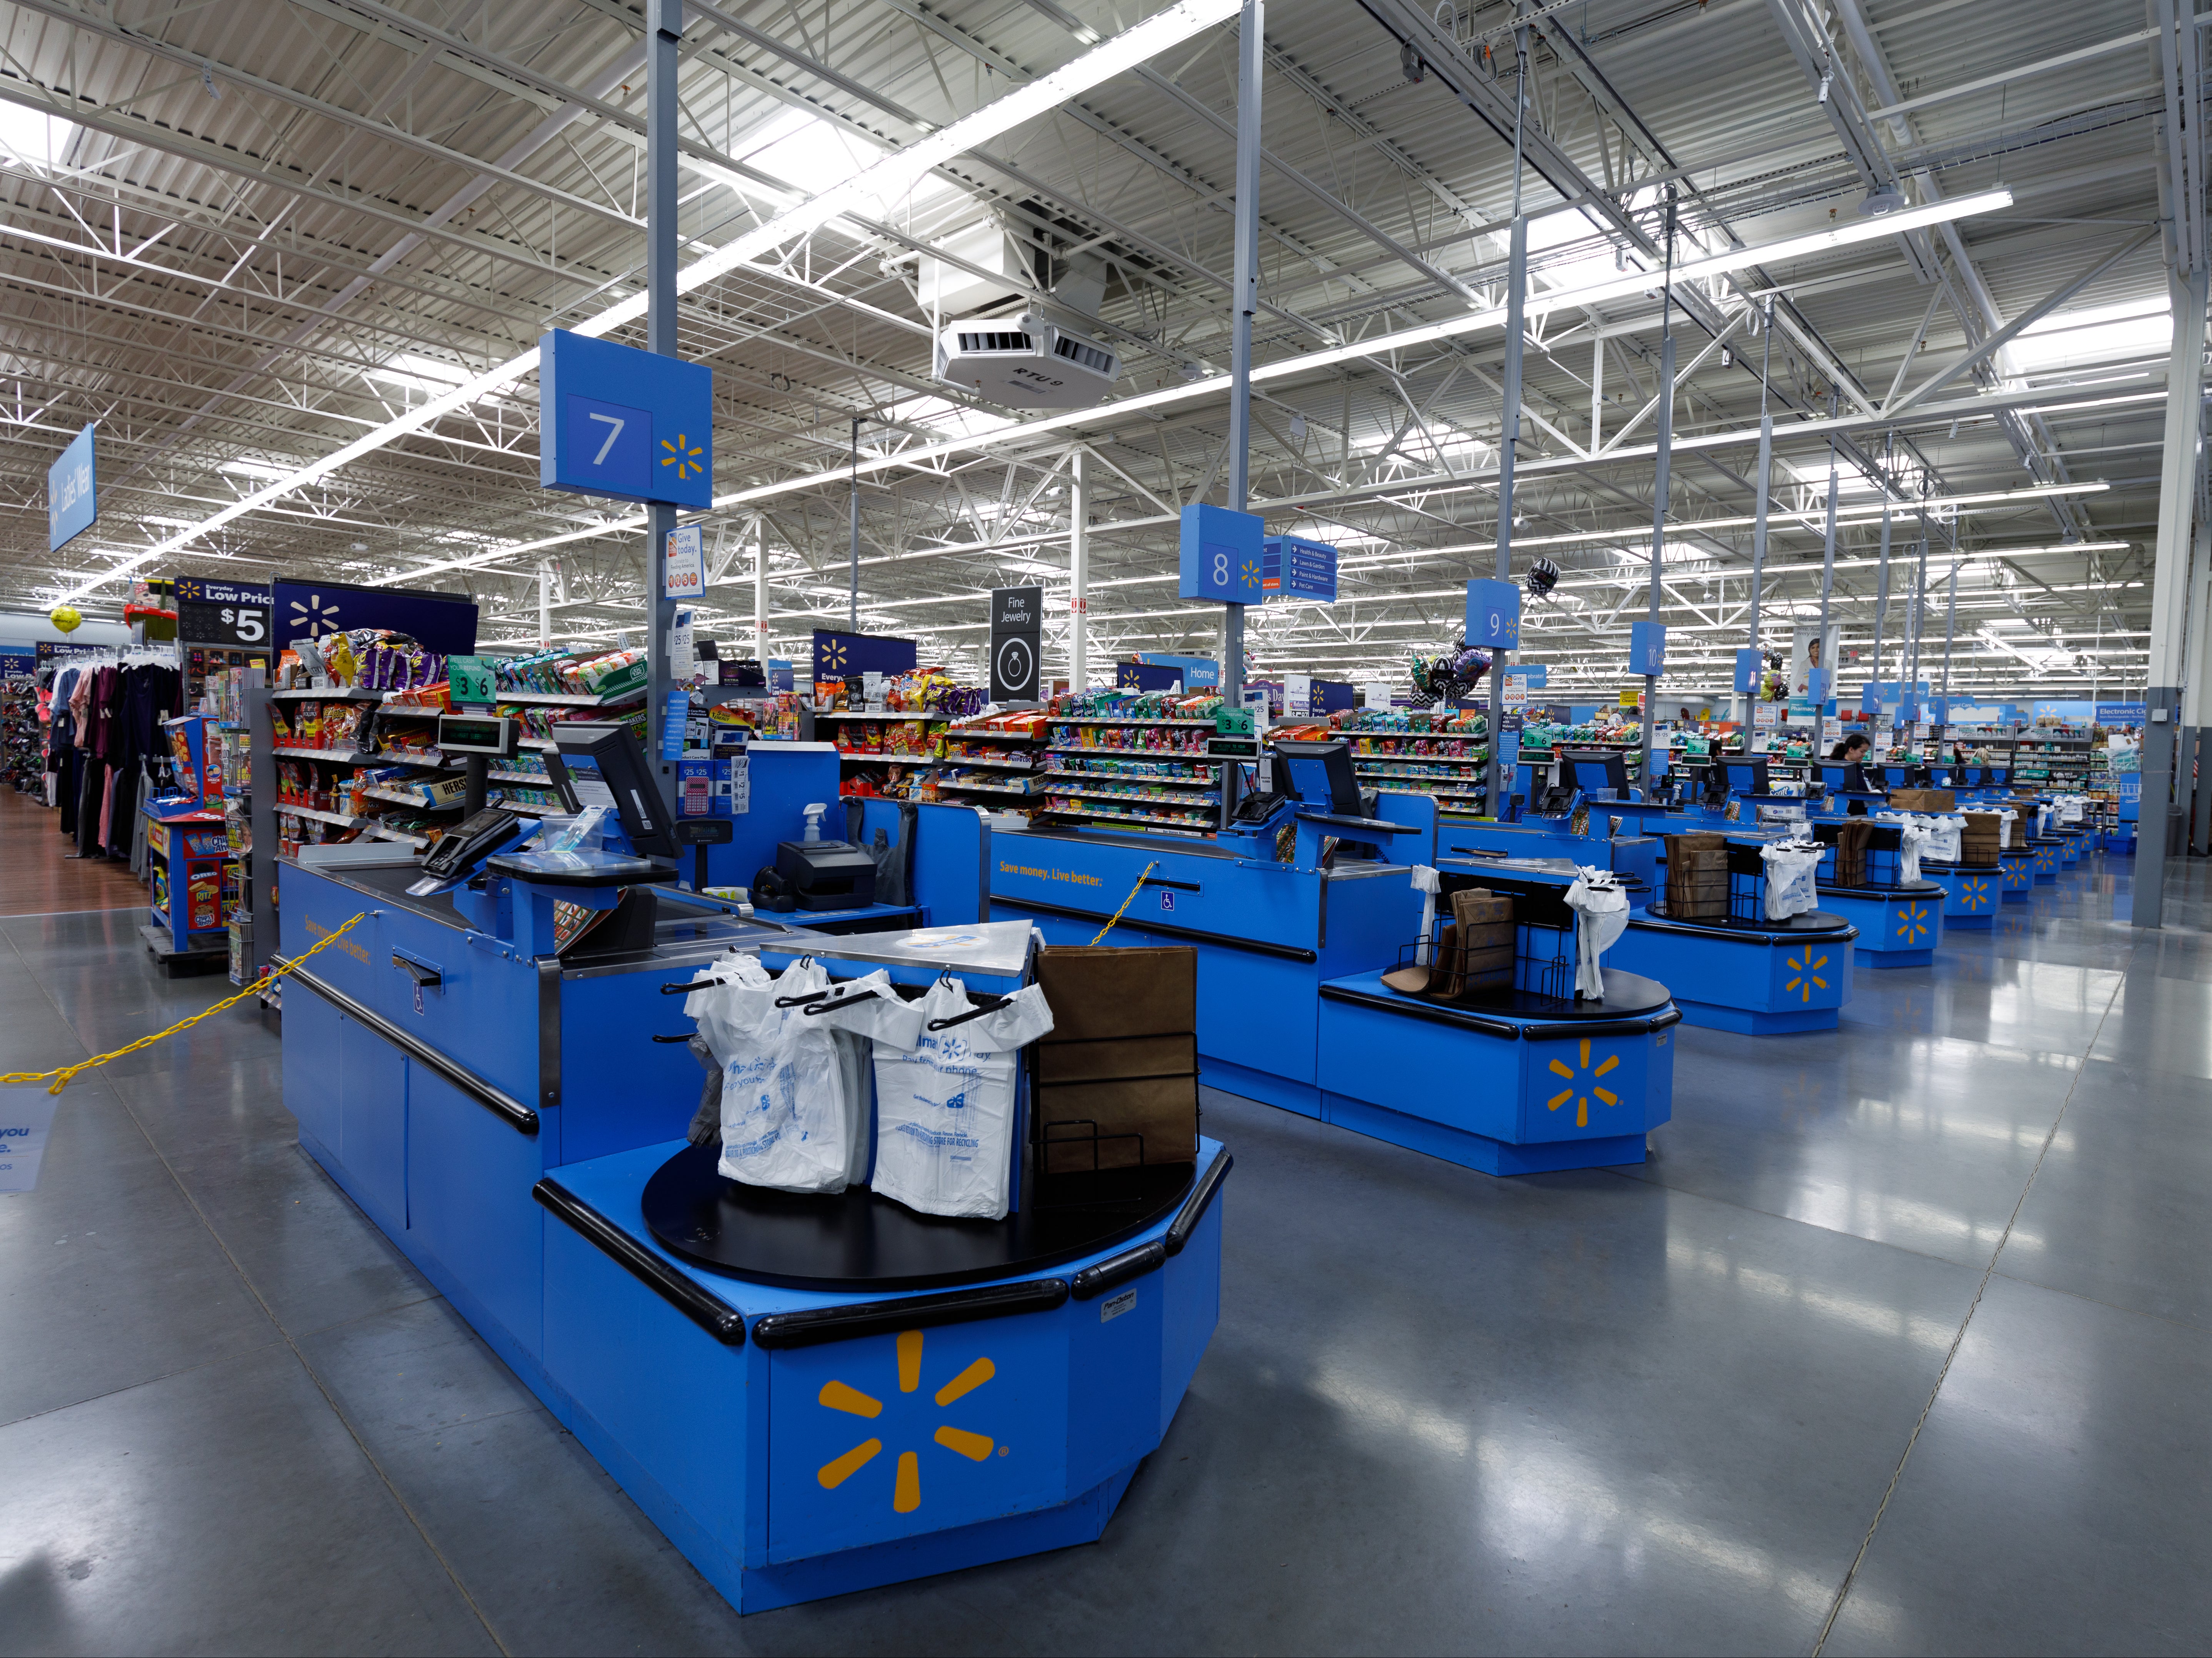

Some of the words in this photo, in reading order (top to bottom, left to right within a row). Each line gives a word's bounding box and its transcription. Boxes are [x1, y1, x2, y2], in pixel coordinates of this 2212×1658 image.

[1013, 368, 1051, 382] RTU
[590, 413, 624, 465] 7
[62, 469, 76, 512] Ladies'
[77, 463, 90, 498] Wear
[678, 533, 690, 543] Give
[678, 545, 697, 555] today.
[1213, 553, 1228, 585] 8
[669, 577, 673, 586] $1
[675, 576, 680, 585] $2
[682, 575, 688, 584] $5
[1312, 573, 1328, 582] Hardware
[206, 590, 238, 602] Low
[1008, 597, 1024, 608] Fine
[1001, 611, 1031, 624] Jewelry
[221, 608, 265, 642] $5
[1490, 613, 1499, 637] 9
[1649, 649, 1657, 667] 10
[1191, 667, 1214, 679] Home
[1750, 670, 1756, 685] 11
[456, 677, 468, 695] $3
[475, 677, 488, 696] $6
[1371, 695, 1389, 704] Hallmark
[1222, 719, 1232, 730] $3
[1237, 720, 1248, 730] $6
[409, 735, 427, 743] SHARE
[1539, 737, 1546, 745] $6
[1770, 786, 1789, 795] Scott
[190, 871, 218, 880] OREO
[1000, 860, 1018, 874] Save
[1020, 866, 1050, 880] money.
[1052, 868, 1069, 882] Live
[1071, 871, 1102, 886] better.
[197, 892, 213, 901] RITZ
[195, 915, 211, 923] Chips
[198, 914, 214, 926] Ahoy!
[305, 914, 317, 935] Save
[338, 936, 348, 954] Live
[350, 938, 370, 965] better.
[946, 1065, 979, 1075] phone.
[762, 1136, 775, 1149] STORE
[933, 1136, 946, 1145] STORE
[956, 1139, 979, 1148] RECYCLING
[1103, 1293, 1134, 1311] Pan-Oston
